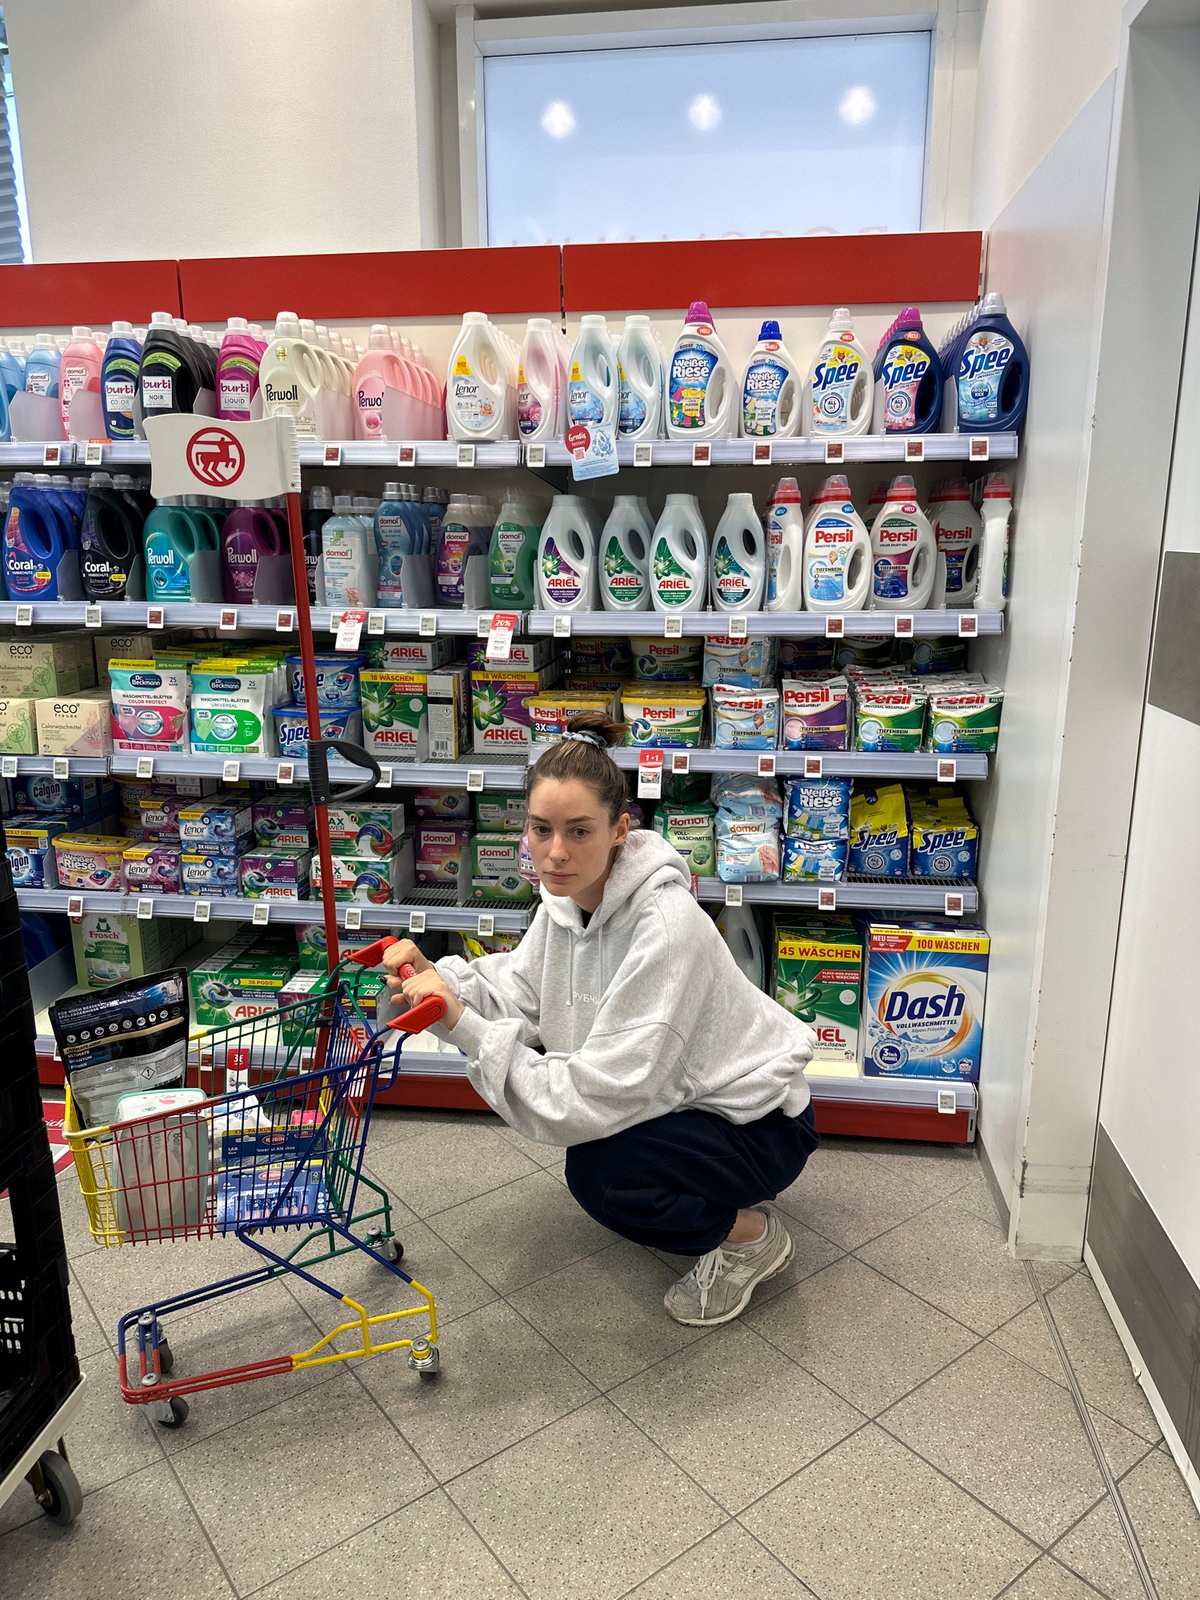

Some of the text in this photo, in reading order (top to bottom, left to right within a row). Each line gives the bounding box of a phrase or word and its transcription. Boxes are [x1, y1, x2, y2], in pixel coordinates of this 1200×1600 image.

[674, 359, 708, 367] Weißer
[960, 348, 1011, 379] Spee
[673, 366, 709, 378] Riese
[813, 362, 859, 390] Spee
[882, 360, 927, 389] Spee
[106, 384, 134, 394] burti
[143, 379, 171, 389] burti
[220, 384, 249, 394] burti
[747, 380, 780, 390] Riese
[265, 384, 298, 402] Perwoll
[456, 384, 479, 396] Lenor
[358, 390, 384, 408] Perwo
[570, 390, 589, 402] Lenor
[815, 529, 853, 543] Persil
[880, 529, 918, 542] Persil
[939, 527, 973, 539] Persil
[147, 547, 174, 565] Perwoll
[227, 547, 257, 564] Perwoll
[9, 559, 34, 571] Coral
[85, 561, 110, 573] Coral
[548, 579, 579, 587] ARIEL
[610, 578, 641, 586] ARIEL
[658, 581, 689, 589] ARIEL
[718, 579, 747, 587] ARIEL
[111, 638, 132, 648] eco
[575, 642, 601, 651] Persil
[10, 645, 32, 655] eco
[390, 647, 427, 658] ARIEL
[649, 644, 679, 655] Persil
[576, 656, 587, 664] 3X
[379, 674, 415, 682] WÄSCHEN
[490, 673, 526, 681] WÄSCHEN
[568, 680, 593, 690] Persil
[784, 689, 829, 703] Persil
[865, 694, 912, 705] Persil
[936, 694, 985, 705] Persil
[53, 703, 78, 713] eco
[534, 707, 562, 719] Persil
[643, 707, 676, 719] Persil
[535, 723, 546, 732] 3X
[373, 730, 417, 743] ARIEL
[483, 729, 528, 741] ARIEL
[33, 782, 61, 798] Calgon
[800, 787, 841, 797] Weißer
[800, 795, 842, 808] Riese
[145, 813, 167, 823] Lenor
[670, 817, 705, 826] domol
[184, 824, 207, 835] Lenor
[730, 825, 760, 833] domol
[277, 835, 307, 843] ARIEL
[423, 834, 452, 843] domol
[853, 831, 897, 849] Spee
[918, 832, 966, 853] Spee
[64, 853, 94, 863] Weißer
[479, 849, 510, 857] domol
[63, 860, 96, 870] Riese
[128, 864, 150, 875] Lenor
[187, 867, 210, 878] Lenor
[265, 888, 296, 896] ARIEL
[89, 931, 119, 940] Frosch
[917, 939, 933, 949] 100
[934, 939, 980, 951] WÄSCHEN
[780, 946, 860, 958] 45 WÄSCHEN
[573, 990, 599, 1005] РУБЧ
[884, 985, 966, 1022] Dash
[896, 1020, 957, 1029] VOLLWASCHMITTEL
[817, 1029, 846, 1042] IEL
[68, 1050, 90, 1058] ULTIMATE
